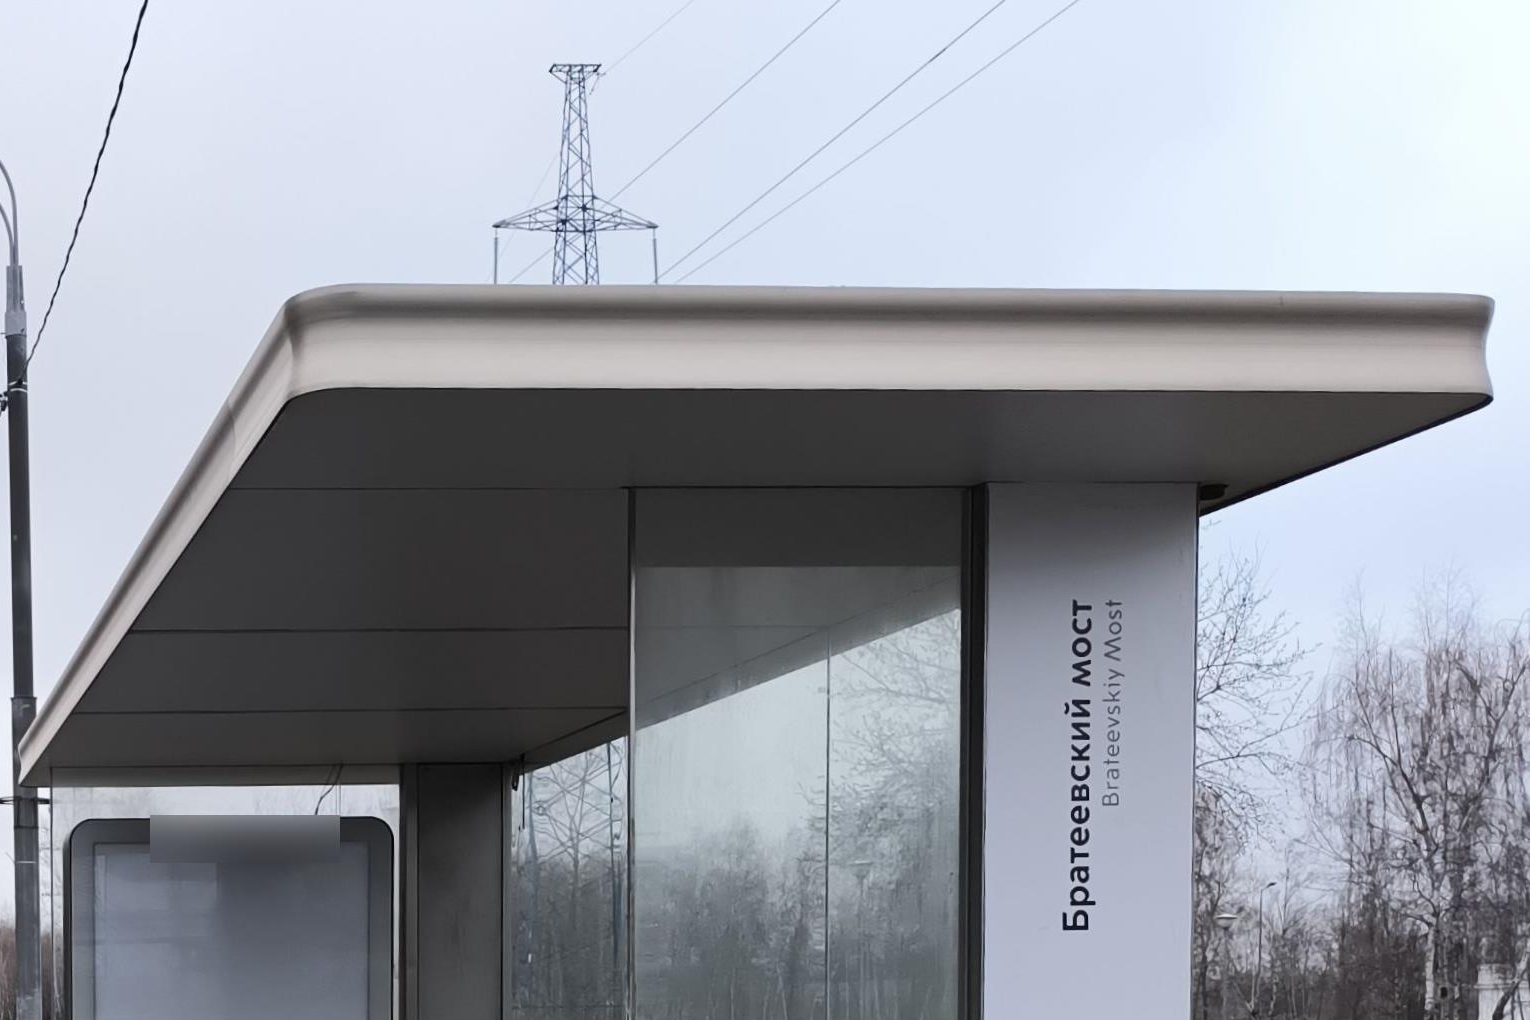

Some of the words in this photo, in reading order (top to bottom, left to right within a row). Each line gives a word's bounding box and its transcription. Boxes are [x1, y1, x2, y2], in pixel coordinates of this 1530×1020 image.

[1071, 598, 1093, 687] мост
[1103, 599, 1124, 662] Most
[1102, 668, 1125, 807] Brateevskiy
[1061, 699, 1096, 932] Братеевский
